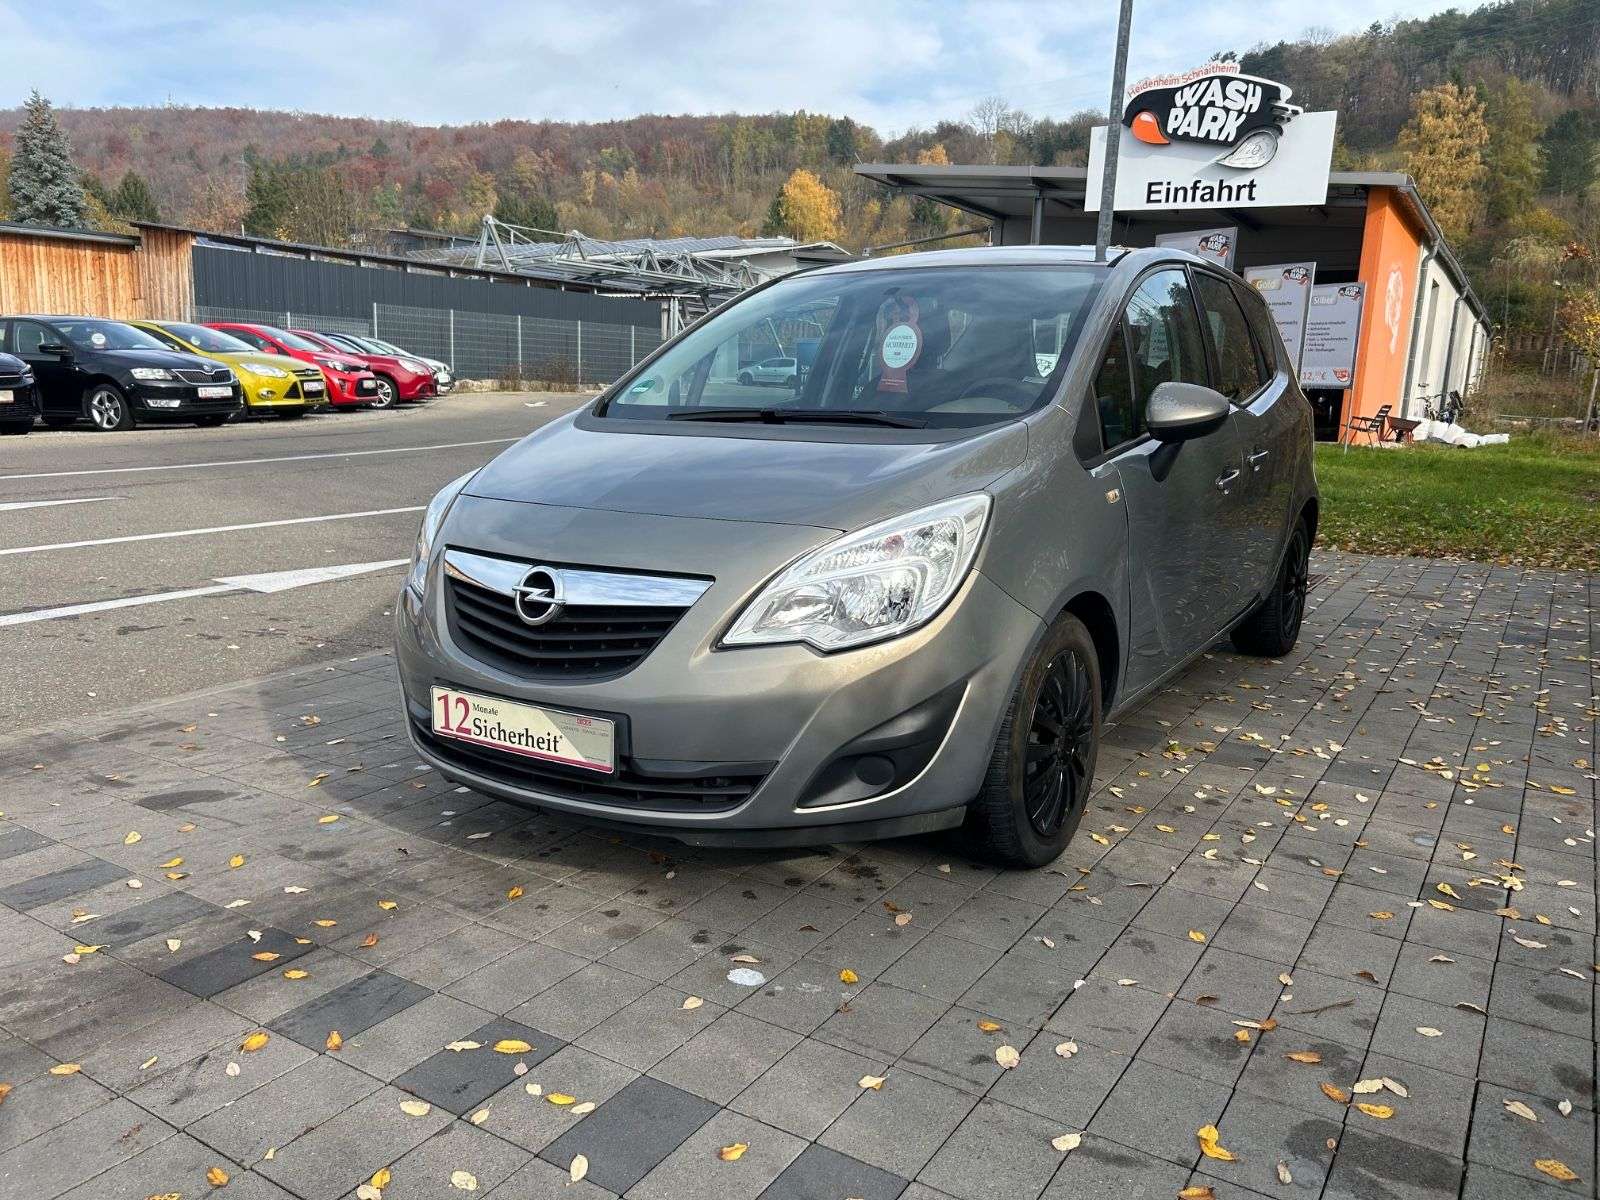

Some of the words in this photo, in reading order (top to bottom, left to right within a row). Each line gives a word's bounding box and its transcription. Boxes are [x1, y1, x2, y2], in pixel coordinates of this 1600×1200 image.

[1127, 77, 1180, 99] Heidenheim
[1181, 63, 1239, 84] Schnaitheim
[1174, 78, 1262, 114] WASH
[1166, 105, 1248, 142] PARK
[1145, 178, 1257, 204] Einfahrt
[436, 693, 472, 736] 12
[472, 702, 499, 717] Monate
